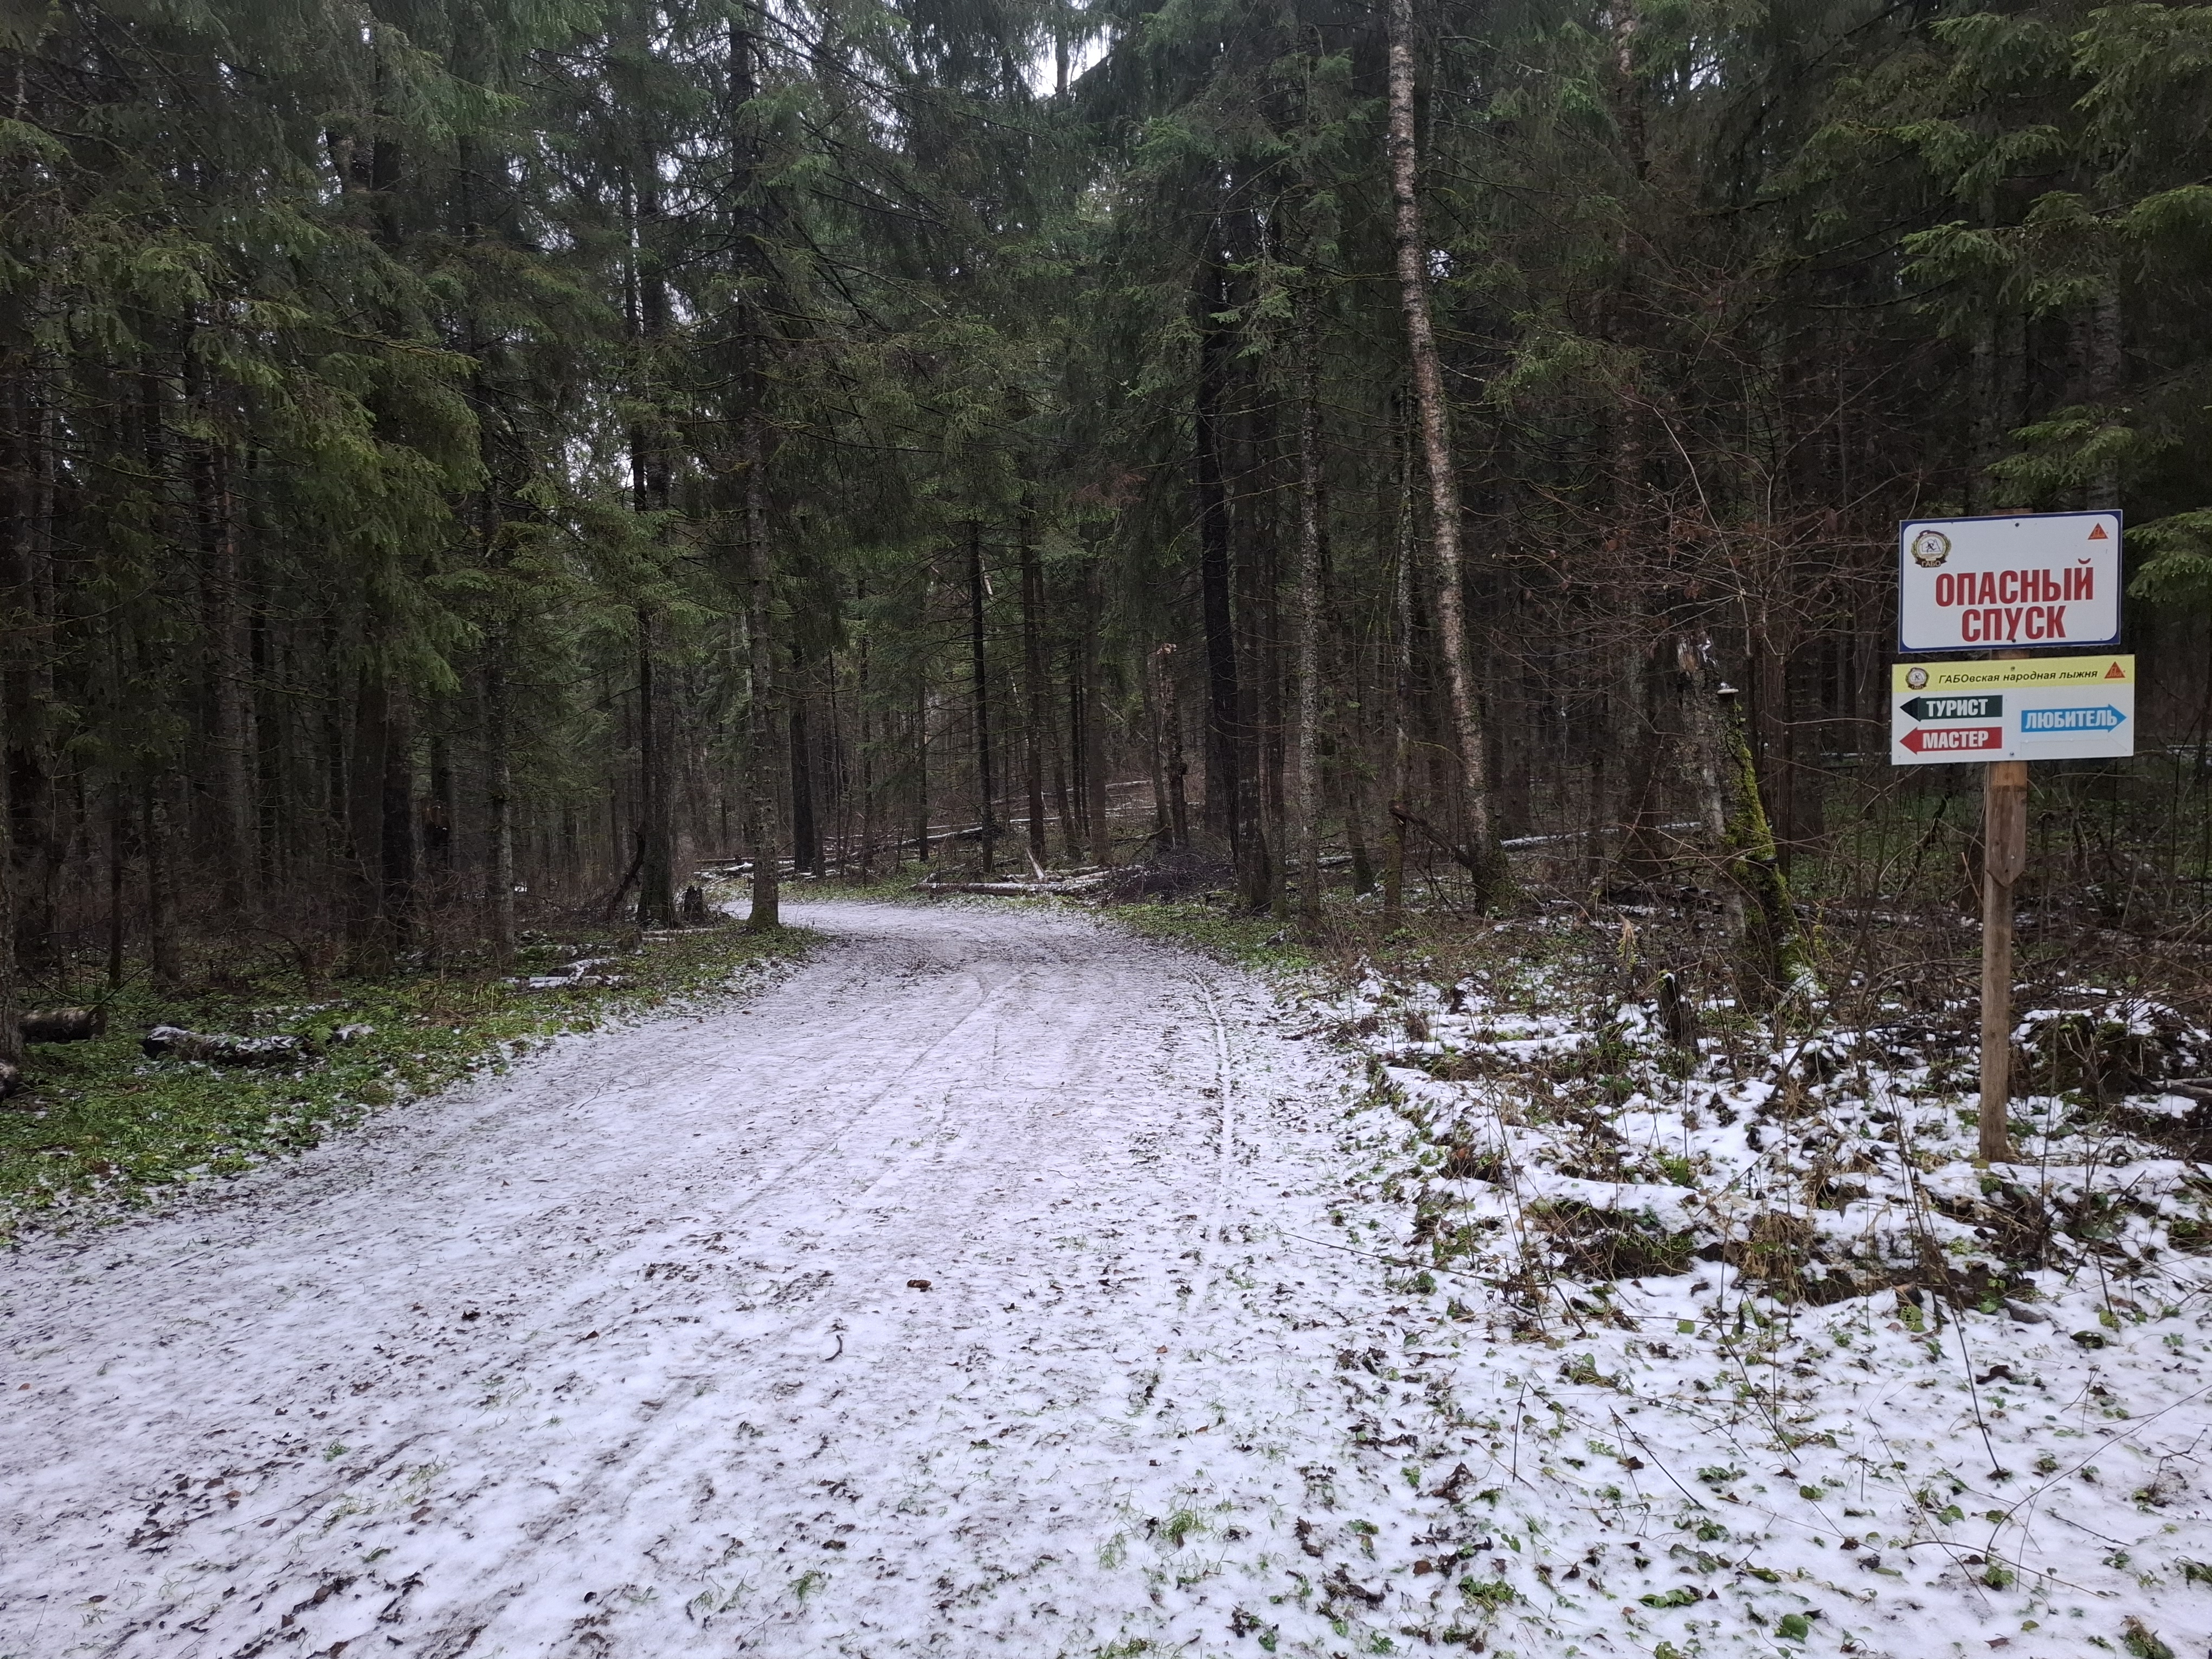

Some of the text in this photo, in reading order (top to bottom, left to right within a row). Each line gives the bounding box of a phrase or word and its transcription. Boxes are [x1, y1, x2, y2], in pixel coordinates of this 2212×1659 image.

[1935, 558, 2093, 607] ОПАСНЫЙ
[1962, 606, 2066, 642] СПУСК
[1939, 671, 2098, 684] ГАБОвская народная лыжня
[1926, 699, 1988, 717] ТУРИСТ
[2025, 709, 2118, 729] ЛЮБИТЕЛЬ
[1922, 730, 1989, 749] МАСТЕР
